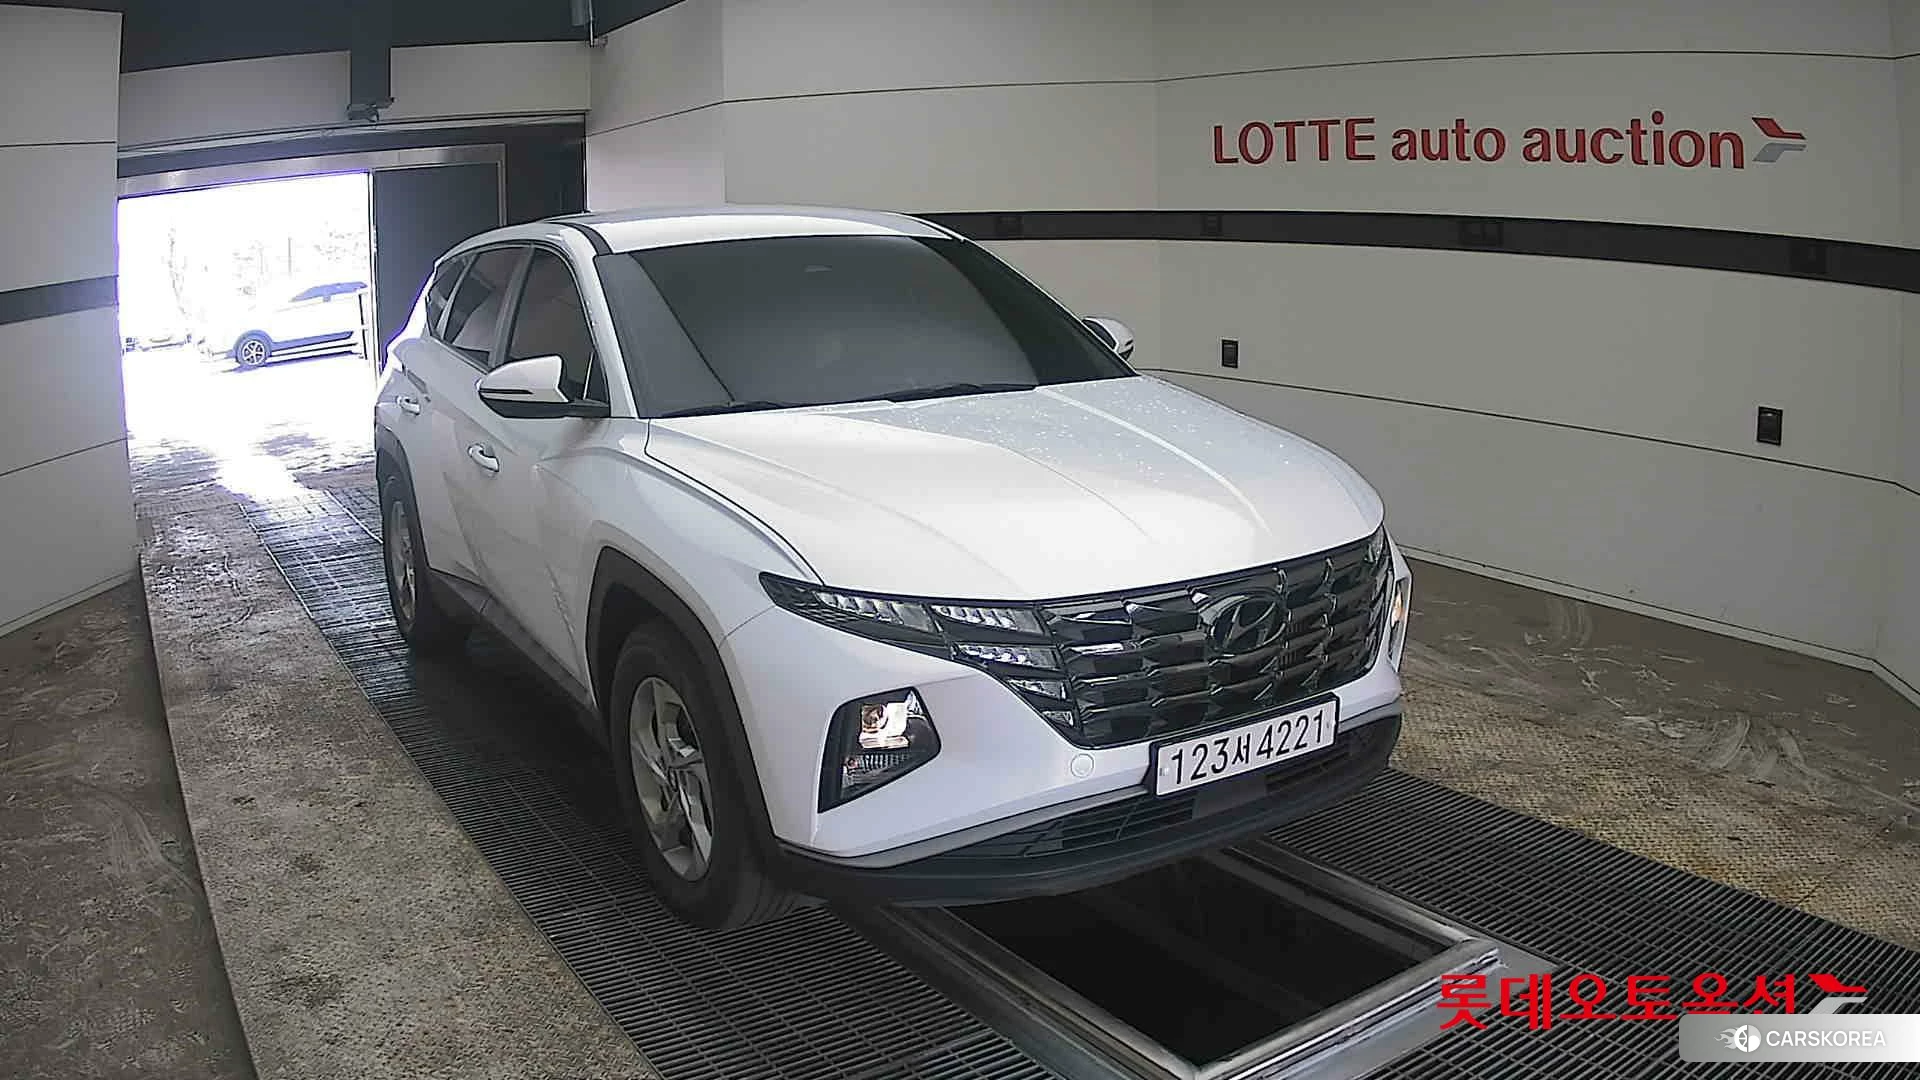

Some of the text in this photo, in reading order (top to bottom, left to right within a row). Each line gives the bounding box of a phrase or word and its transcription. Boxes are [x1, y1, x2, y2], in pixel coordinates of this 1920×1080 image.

[1213, 110, 1745, 169] LOTTE auto auction
[1171, 709, 1323, 785] 123서4221
